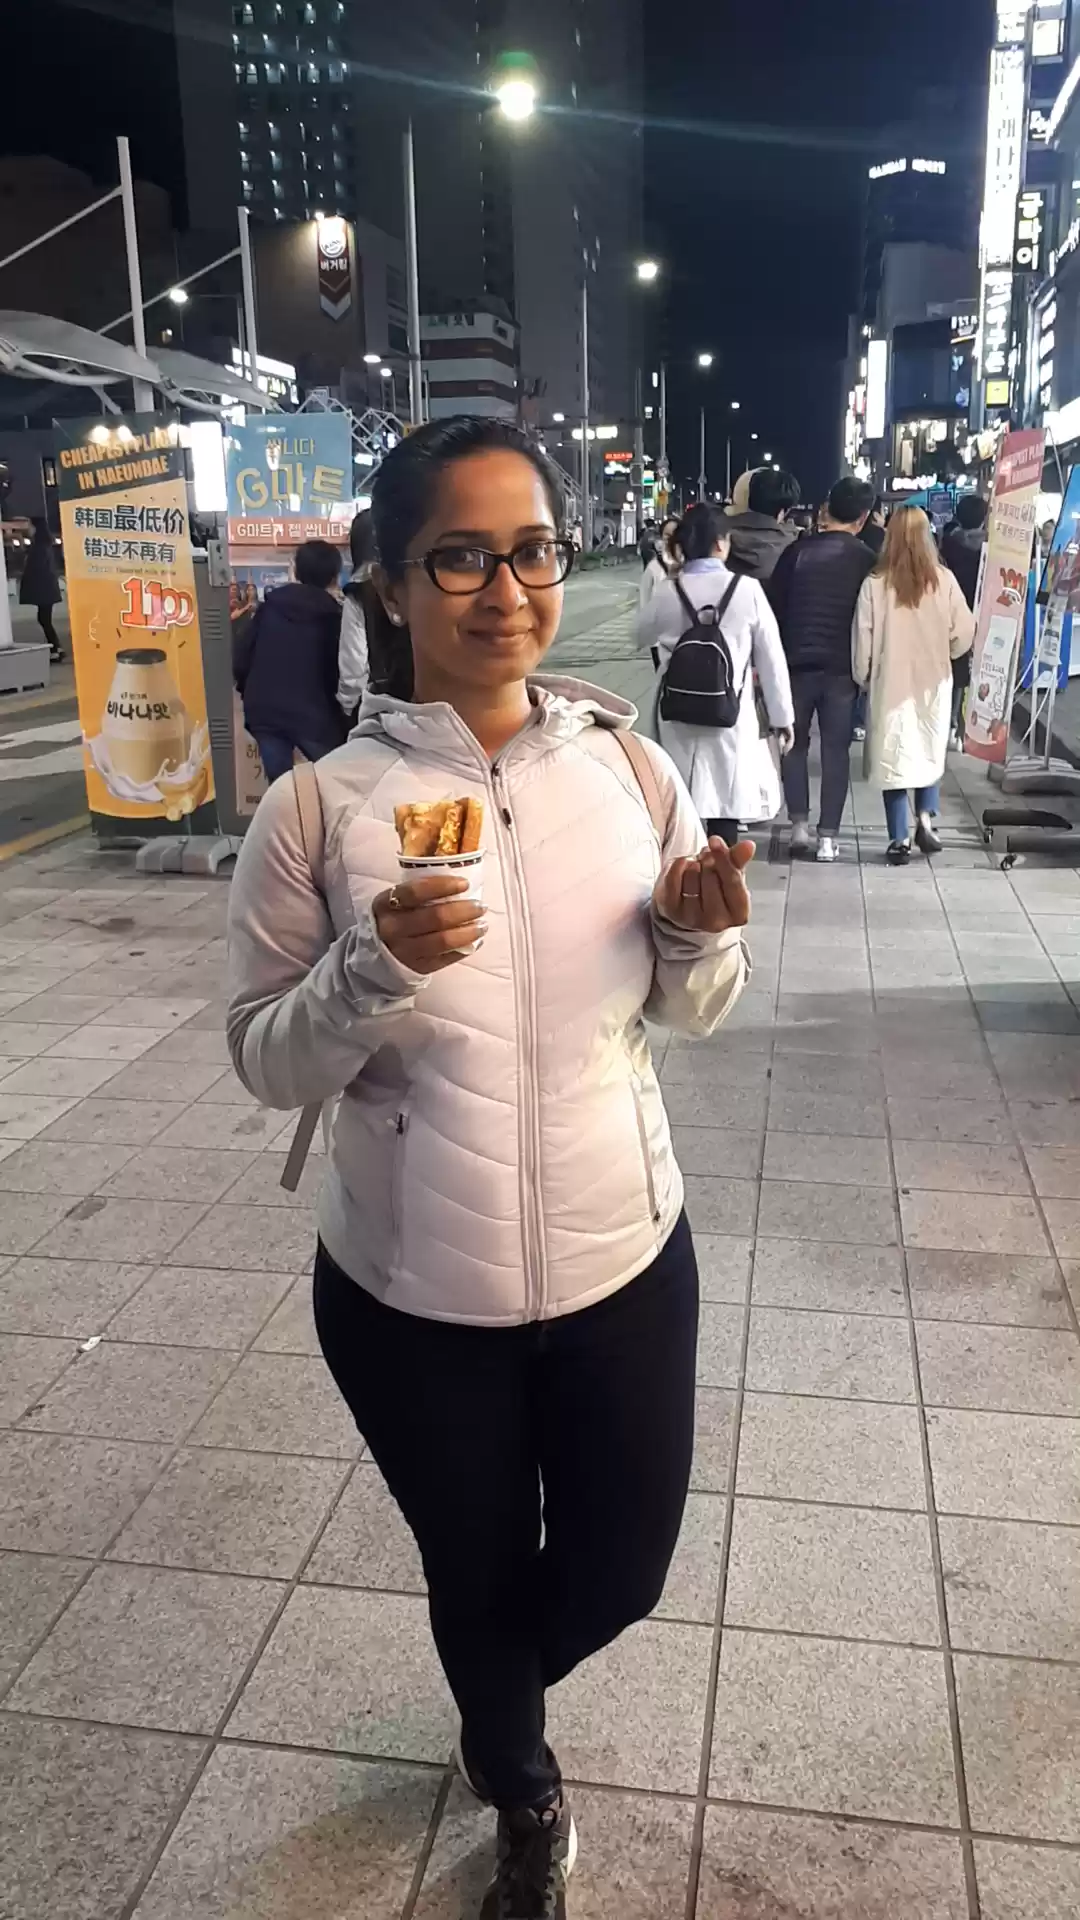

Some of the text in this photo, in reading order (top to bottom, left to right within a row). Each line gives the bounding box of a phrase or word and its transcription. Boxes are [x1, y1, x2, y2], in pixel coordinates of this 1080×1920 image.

[78, 456, 169, 489] IN HAEUNDAE
[236, 463, 345, 508] G마트
[74, 505, 185, 534] 韩国最低价
[84, 537, 175, 562] 错过不再有
[107, 700, 171, 720] 바나나맛
